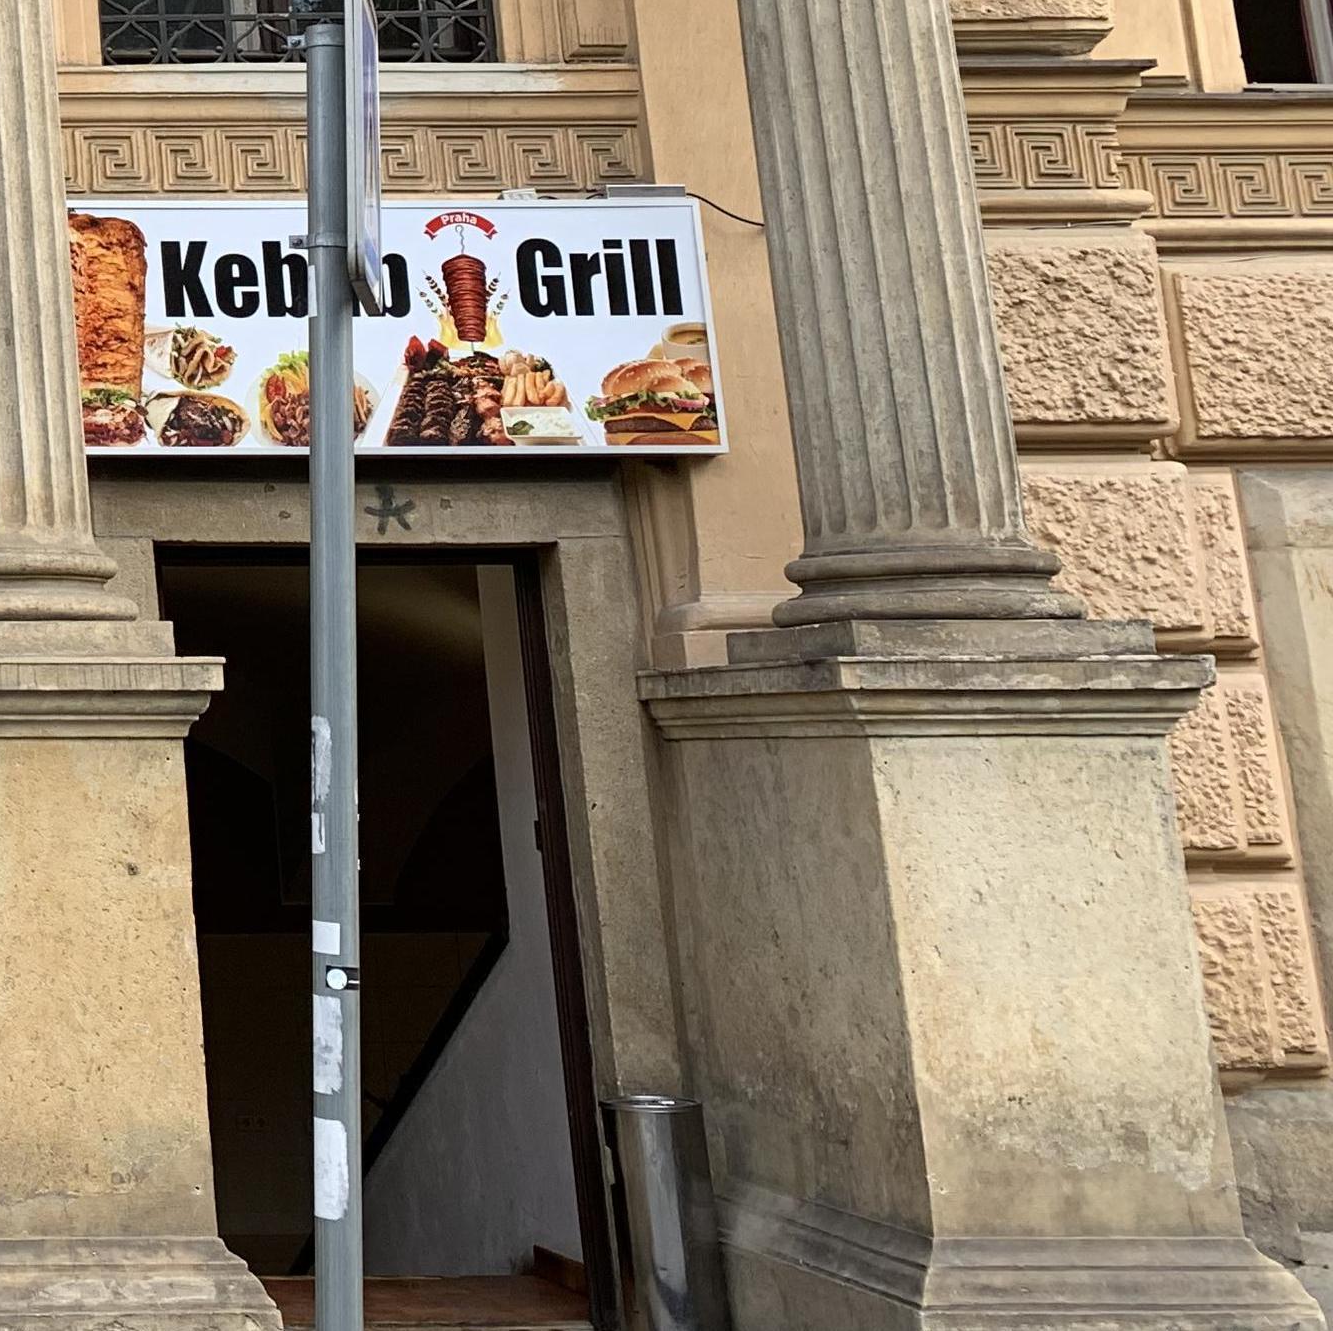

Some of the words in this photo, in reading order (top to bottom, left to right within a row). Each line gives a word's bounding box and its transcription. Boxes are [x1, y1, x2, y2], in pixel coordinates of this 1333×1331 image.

[440, 213, 478, 225] Praha
[161, 240, 411, 318] Kebb
[516, 238, 684, 318] Grill
